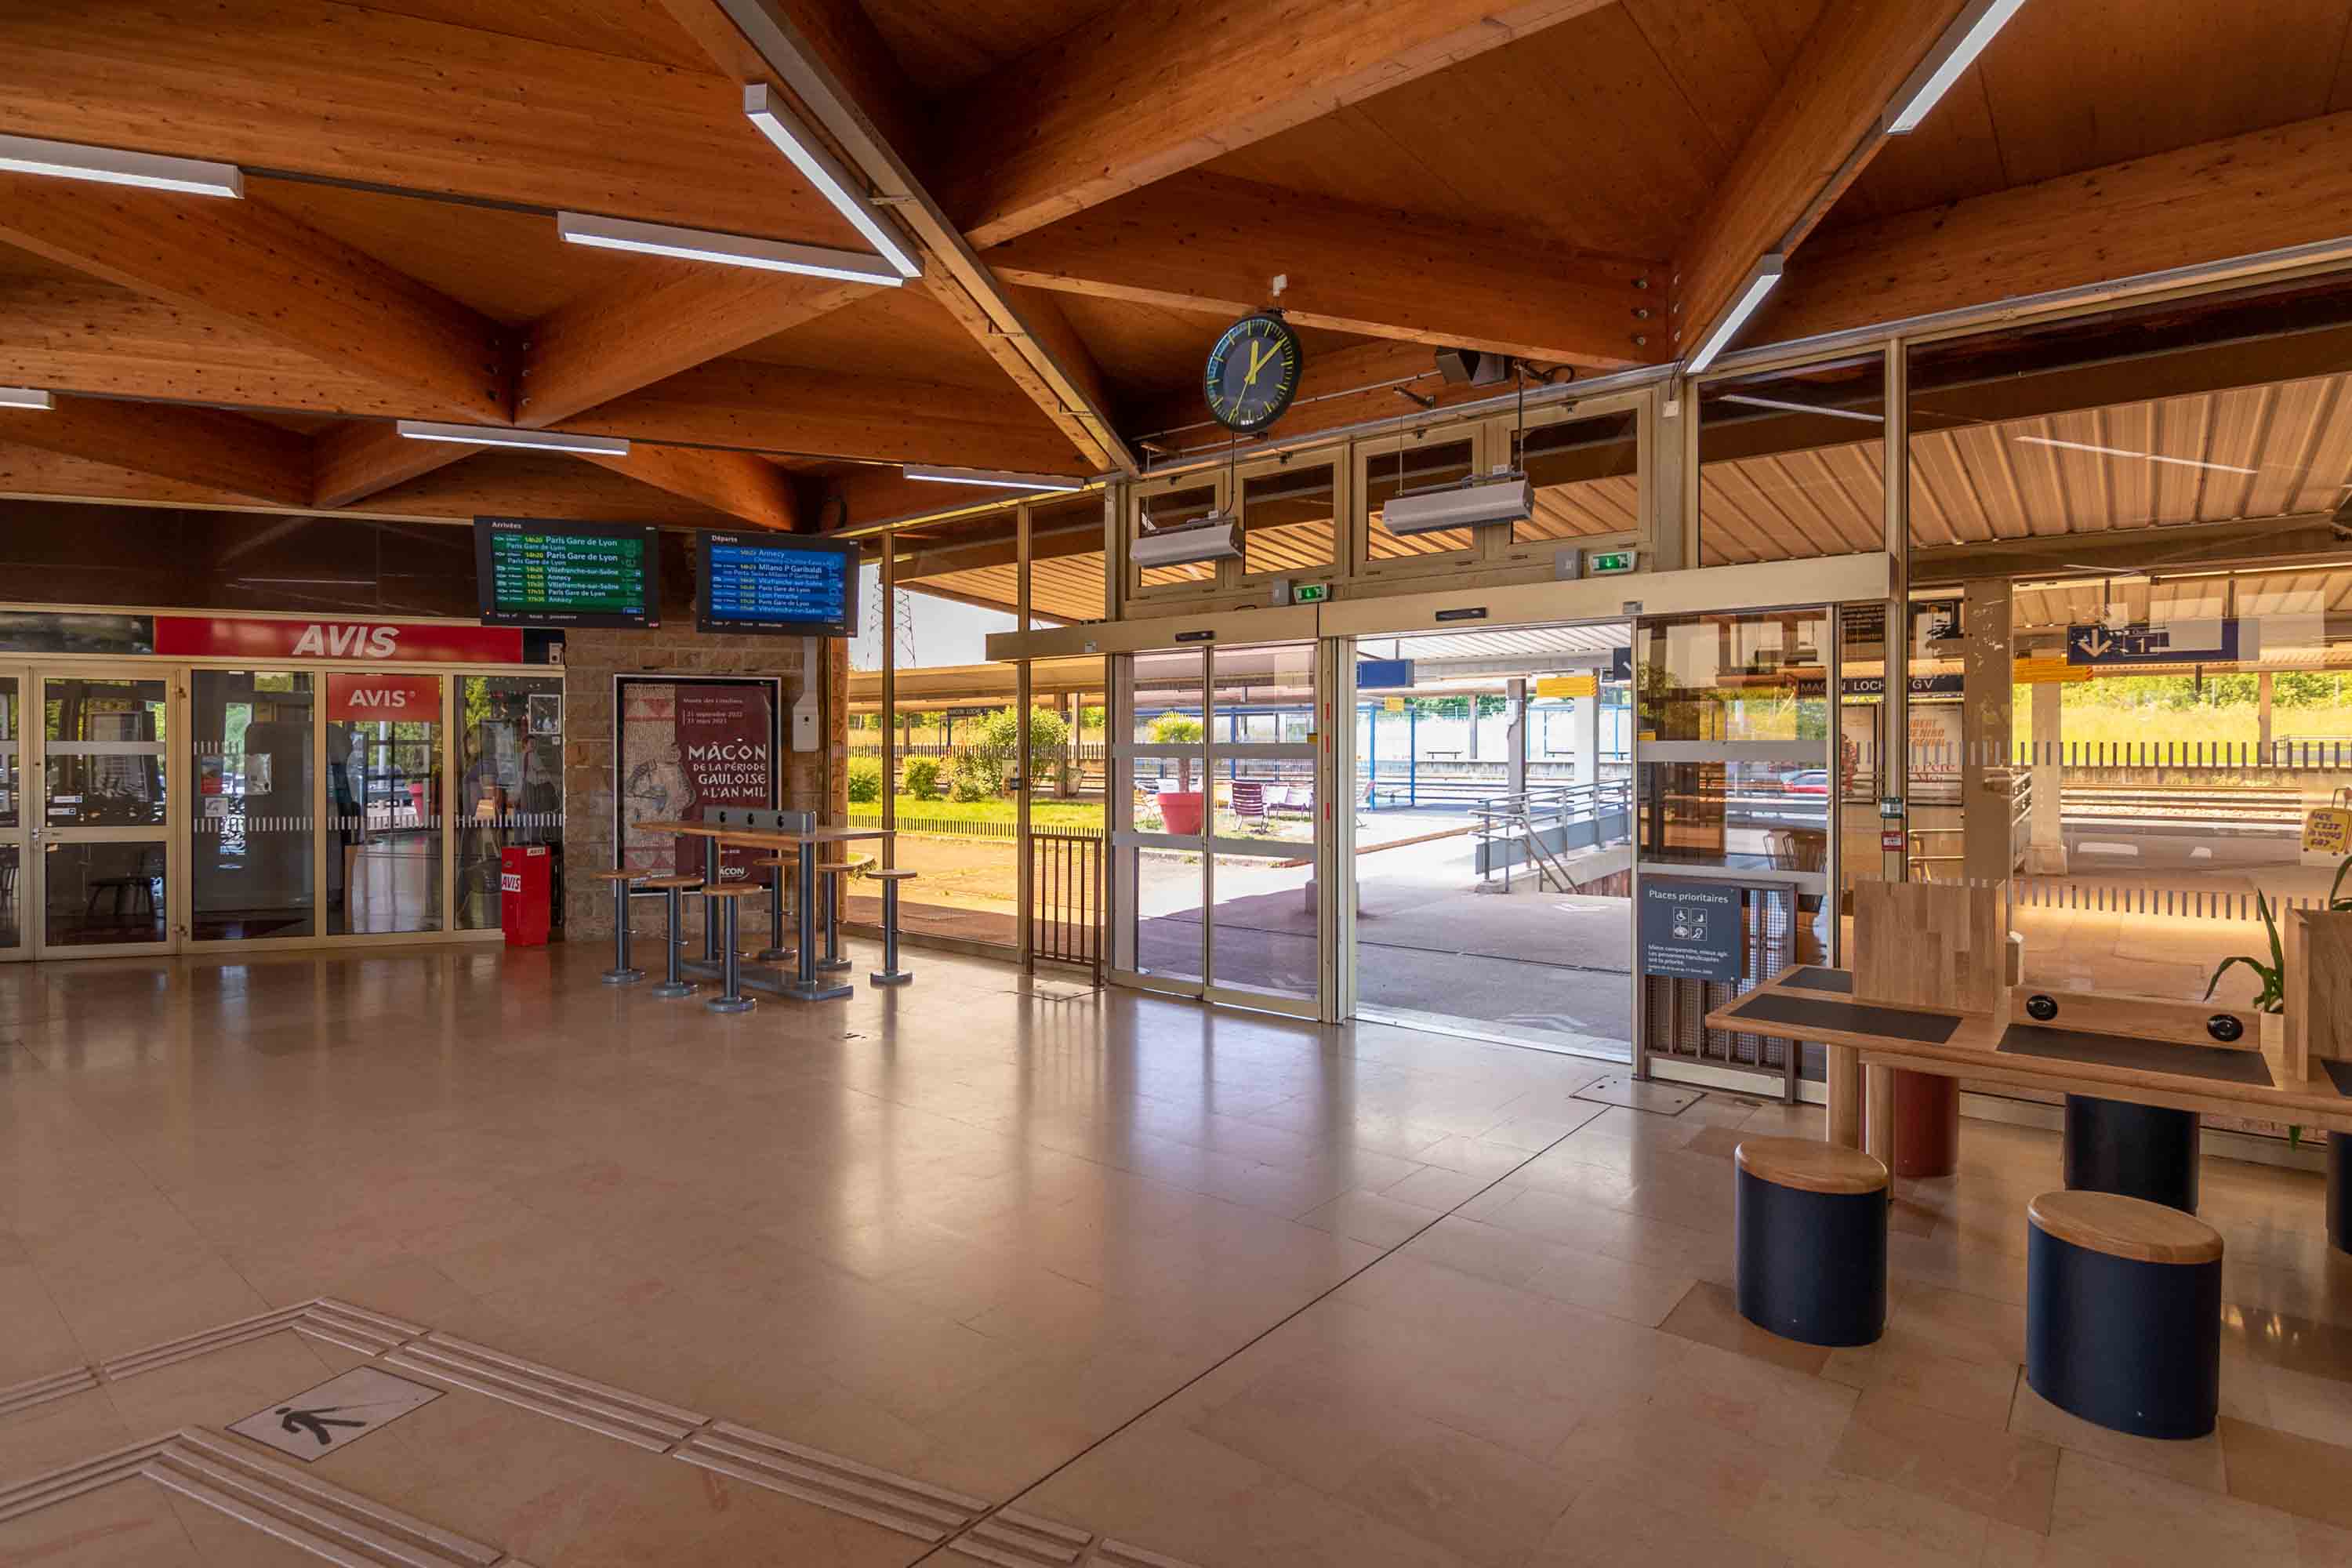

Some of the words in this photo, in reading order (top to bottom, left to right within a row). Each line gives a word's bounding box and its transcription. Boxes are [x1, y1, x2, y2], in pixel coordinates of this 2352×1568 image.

[492, 521, 521, 530] Arrivées
[546, 535, 564, 544] Paris
[598, 539, 617, 548] Lyon
[599, 554, 618, 563] Lyon
[759, 549, 785, 559] Annecy
[790, 565, 822, 574] Garibaldi
[292, 624, 401, 658] AVIS
[2135, 637, 2146, 654] 1
[1802, 681, 1846, 691] MAC
[1853, 681, 1885, 691] LOCH
[1908, 679, 1934, 690] GV
[348, 689, 407, 707] AVIS
[688, 741, 766, 760] MÂCON
[693, 763, 706, 772] DE
[709, 763, 722, 772] LA
[724, 761, 766, 774] PÉRIODE
[698, 773, 766, 785] GAULOISE
[710, 785, 739, 798] L'AN
[742, 786, 766, 797] MIL
[502, 876, 521, 891] AVIS
[1649, 889, 1677, 900] Places
[1679, 892, 1730, 904] prioritaires
